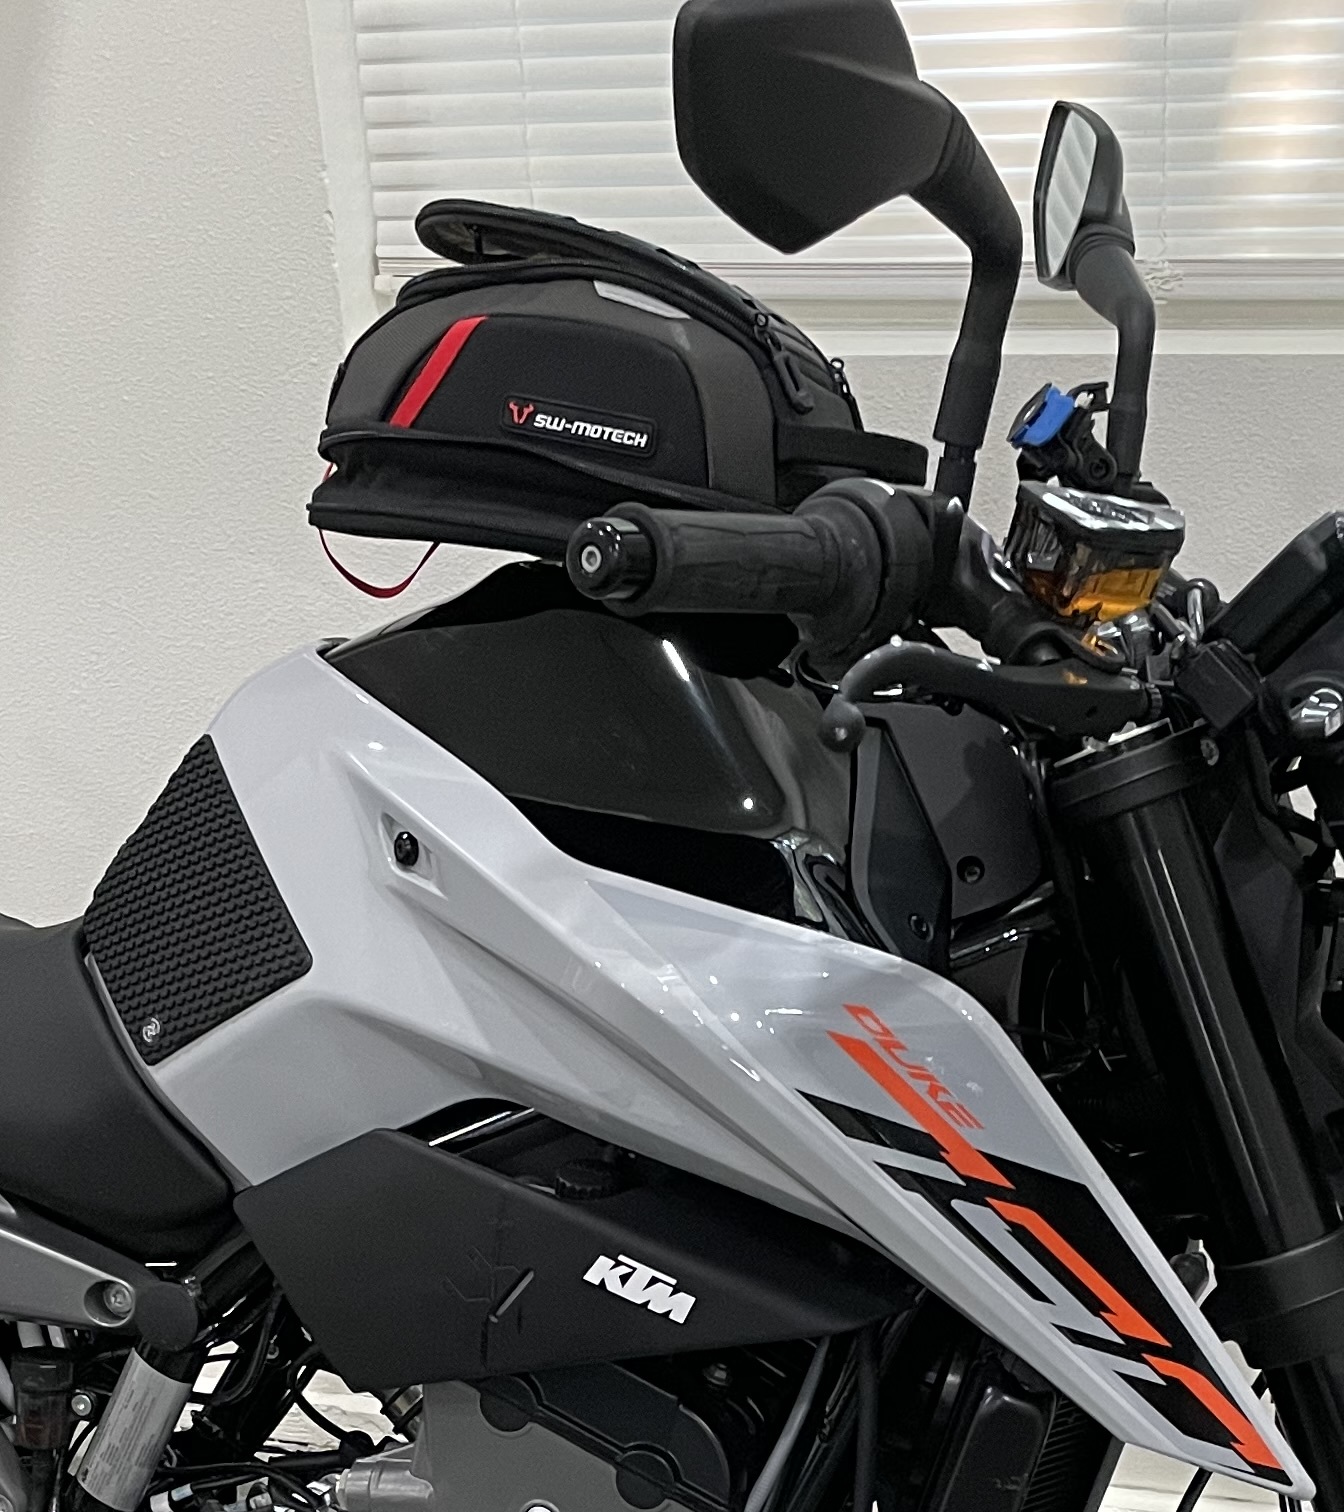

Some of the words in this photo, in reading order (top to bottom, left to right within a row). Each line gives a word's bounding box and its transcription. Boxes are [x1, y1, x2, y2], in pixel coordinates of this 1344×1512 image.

[533, 413, 649, 450] SW-MOTECH
[842, 1003, 985, 1130] DUKE
[583, 1254, 696, 1324] KTM
